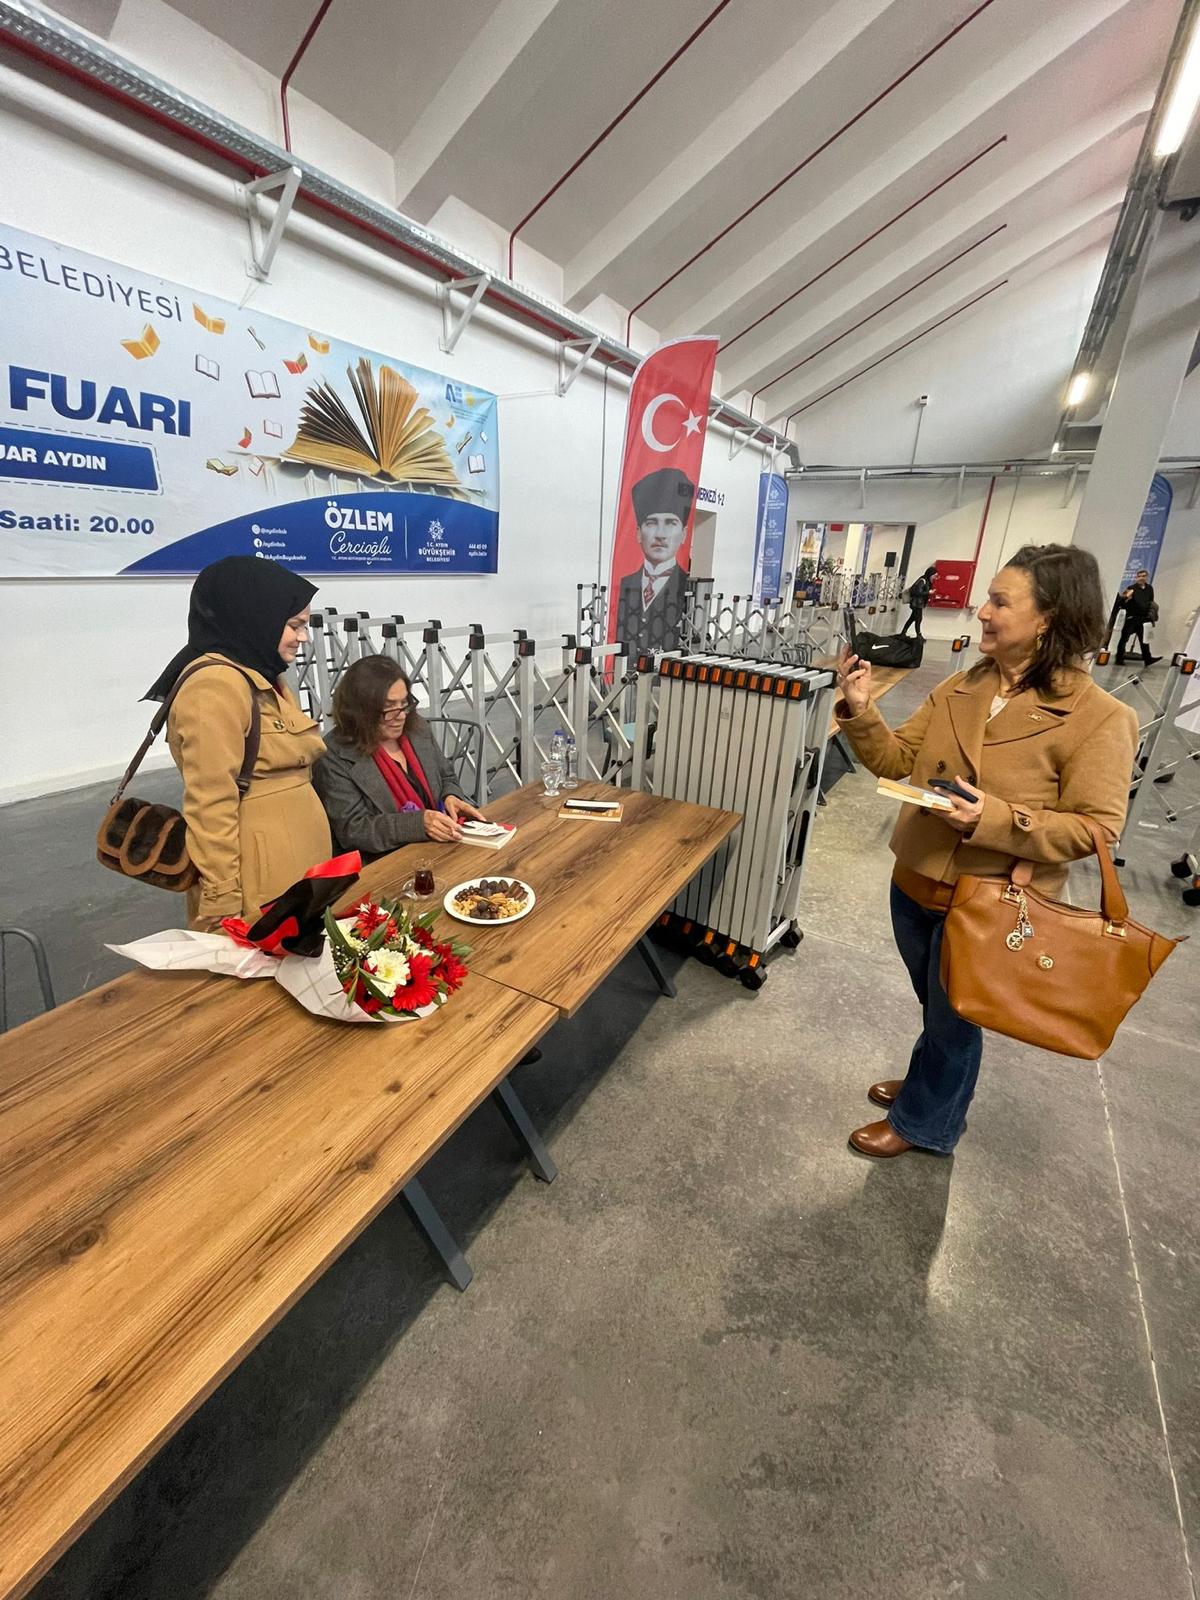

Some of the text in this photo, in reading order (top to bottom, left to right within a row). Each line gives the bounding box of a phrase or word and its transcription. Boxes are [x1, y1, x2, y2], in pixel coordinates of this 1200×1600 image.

[8, 365, 191, 437] FUARI
[43, 450, 107, 471] AYDIN
[0, 509, 154, 535] Saati: 20.00
[324, 501, 394, 532] ÖZLEM
[418, 547, 456, 557] BÜYÜKŞEHİR
